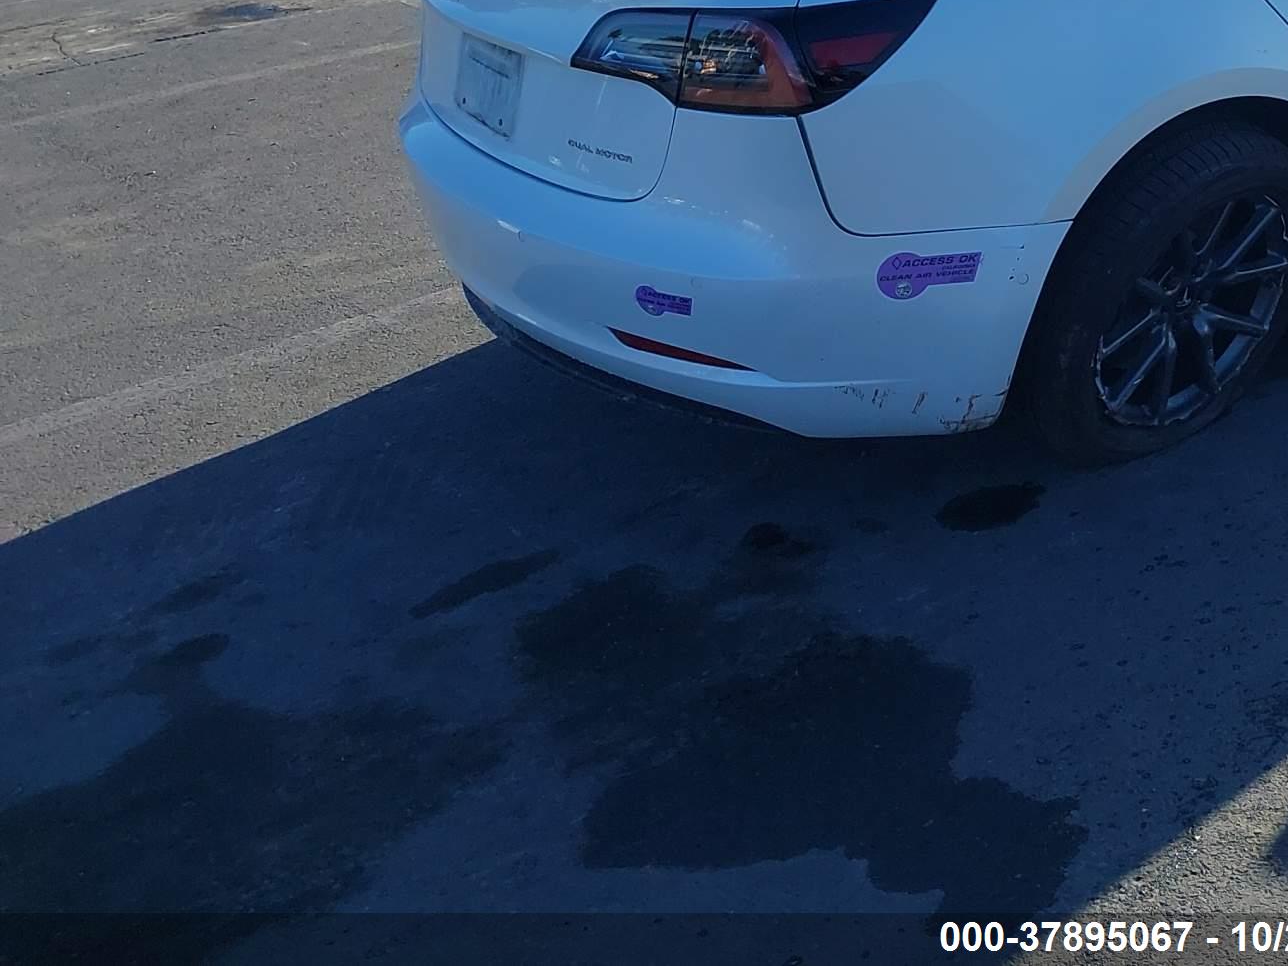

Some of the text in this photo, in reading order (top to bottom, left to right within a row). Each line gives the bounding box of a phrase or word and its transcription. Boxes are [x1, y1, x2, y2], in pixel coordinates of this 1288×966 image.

[595, 147, 633, 164] MOTOR
[902, 254, 978, 268] ACCESS OK
[879, 273, 912, 282] CLEAN
